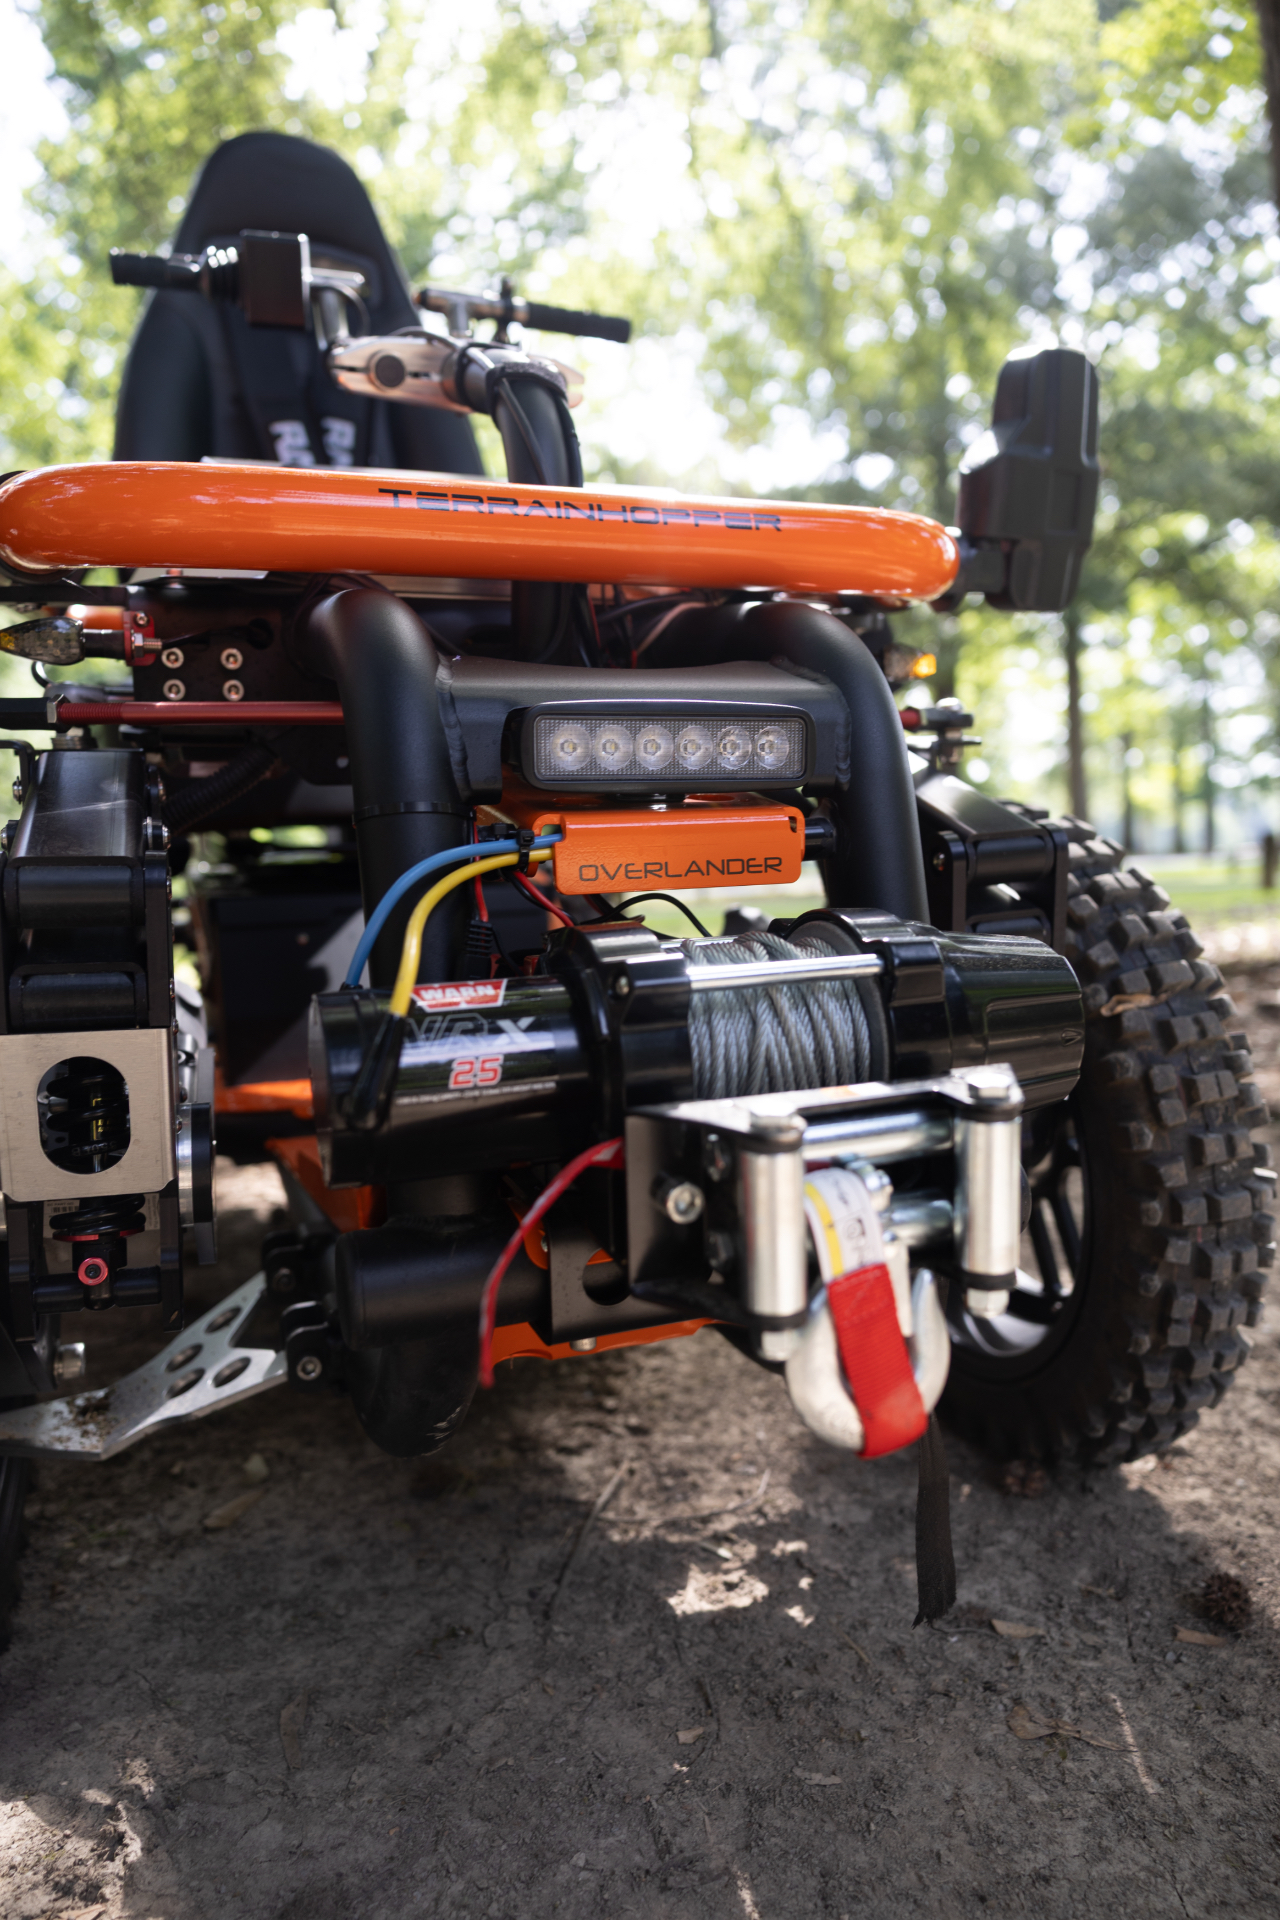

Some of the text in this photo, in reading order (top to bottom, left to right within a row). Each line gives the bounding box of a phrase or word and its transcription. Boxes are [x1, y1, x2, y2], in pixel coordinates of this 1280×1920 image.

[378, 488, 781, 532] TERRAINHOPPER
[579, 857, 782, 882] OVERLANDER
[420, 985, 495, 1000] WARN
[449, 1054, 504, 1089] 25
